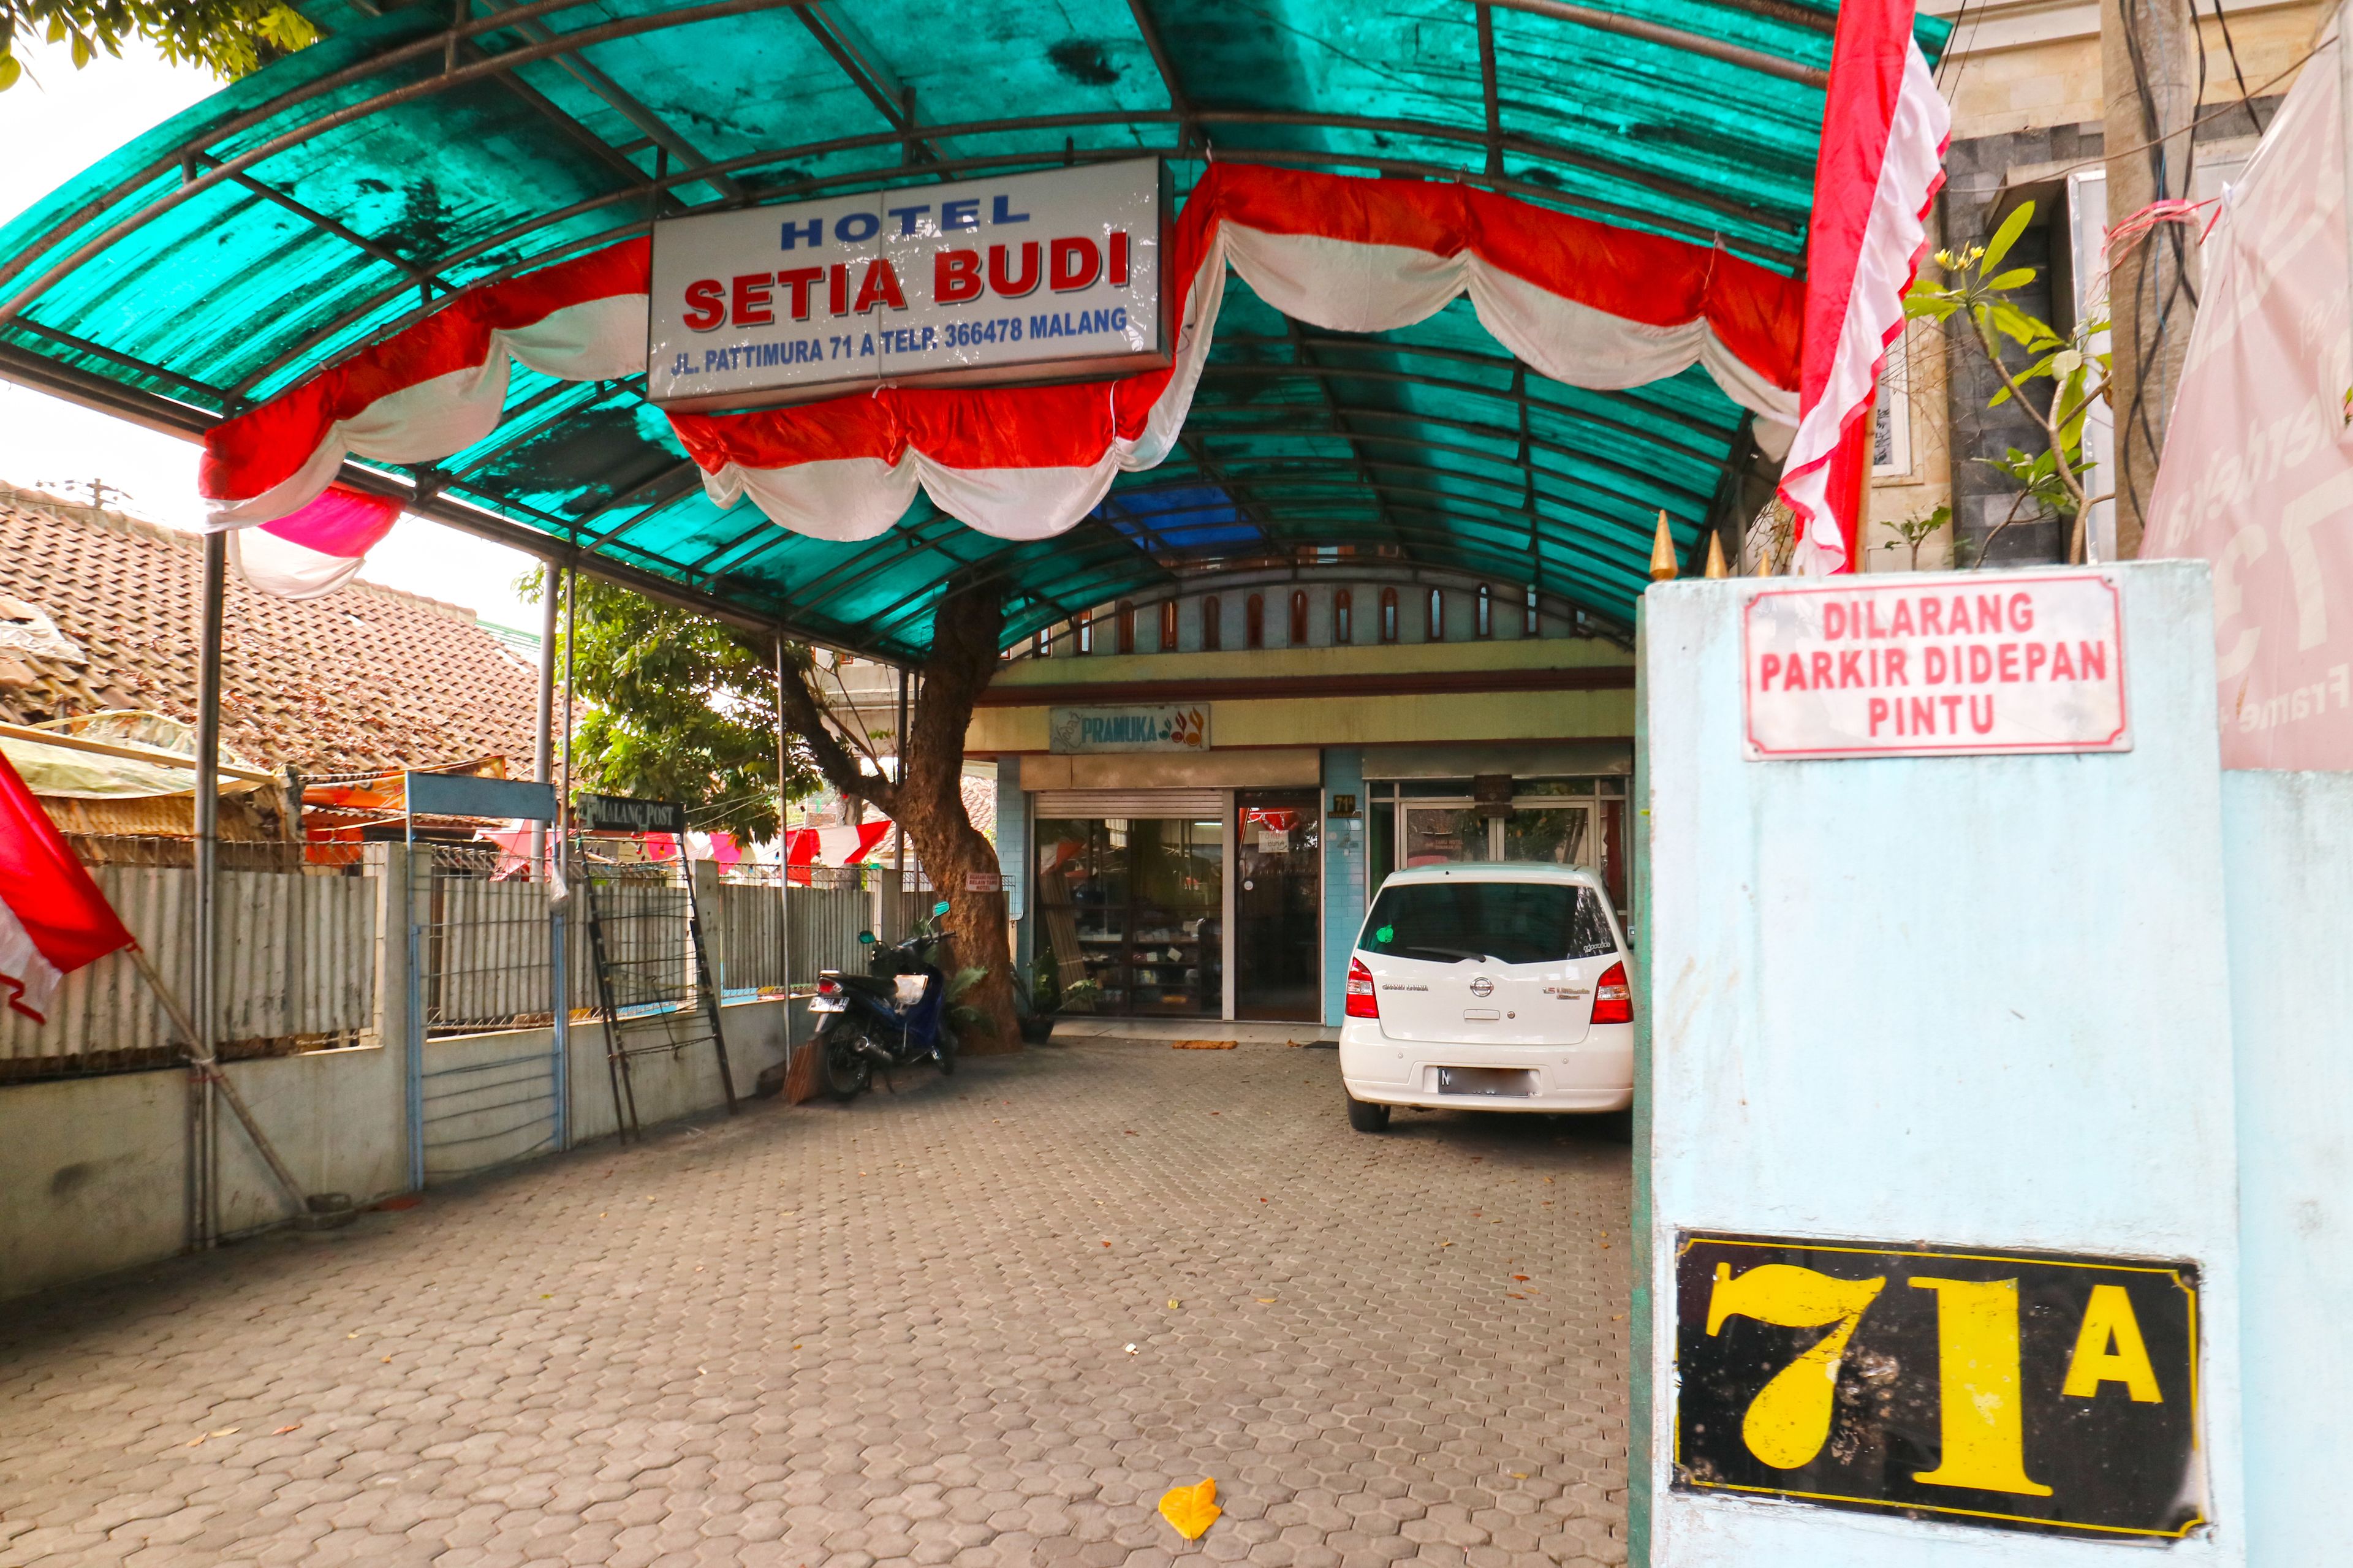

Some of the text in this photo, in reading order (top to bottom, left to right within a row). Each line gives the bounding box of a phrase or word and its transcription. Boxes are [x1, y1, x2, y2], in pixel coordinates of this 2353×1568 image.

[780, 195, 1030, 251] HOTEL
[682, 232, 1131, 332] SETIA BUDI
[671, 308, 1127, 376] JL. PATTIMURA 71 A TELP. 366478 MALANG
[1824, 593, 2034, 641] DILARANG
[1760, 641, 2107, 691] PARKIR DIDEPAN
[1082, 716, 1158, 743] PRAMUKA
[1869, 694, 1994, 737] PINTU
[596, 800, 642, 825] MALANG
[646, 804, 673, 825] POST
